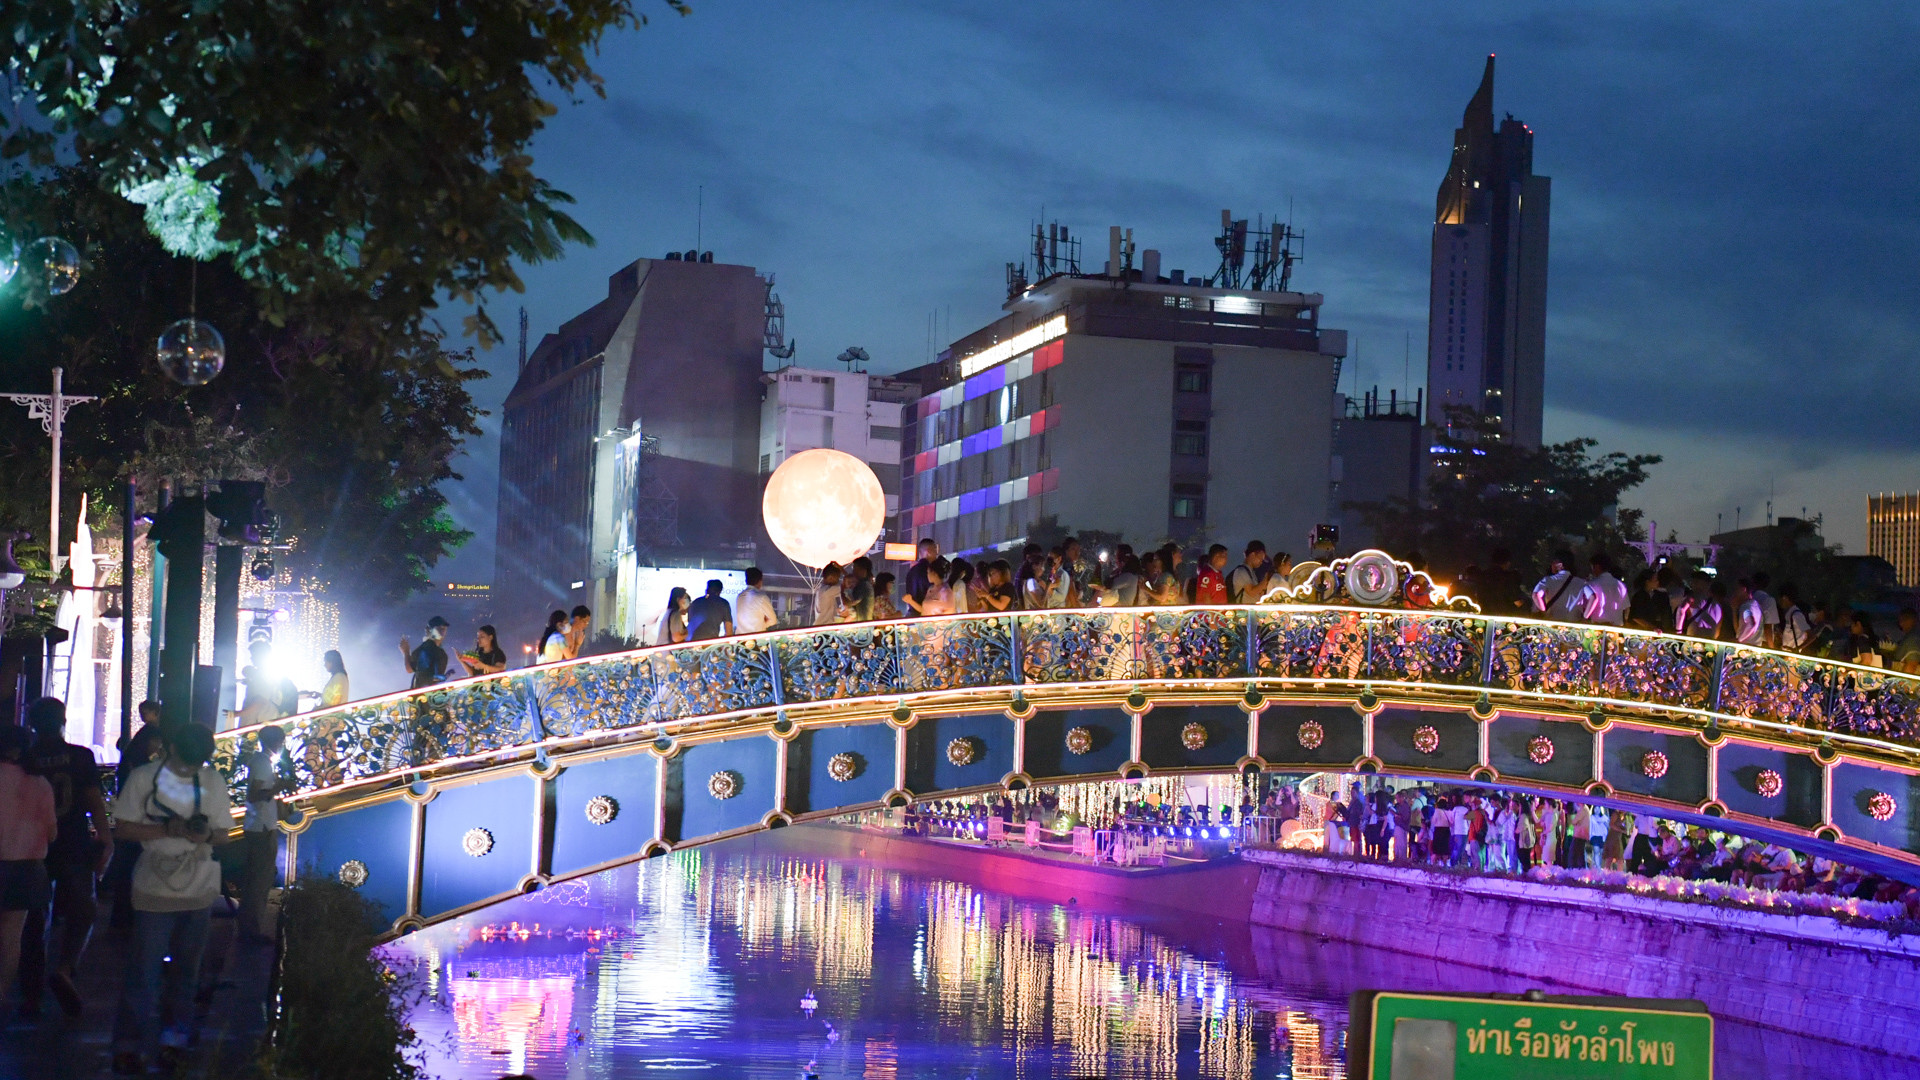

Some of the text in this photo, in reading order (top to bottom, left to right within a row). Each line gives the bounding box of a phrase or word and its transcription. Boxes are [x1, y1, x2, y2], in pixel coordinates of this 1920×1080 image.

[1466, 1017, 1675, 1066] ท่าเรือหัวลำโพง
